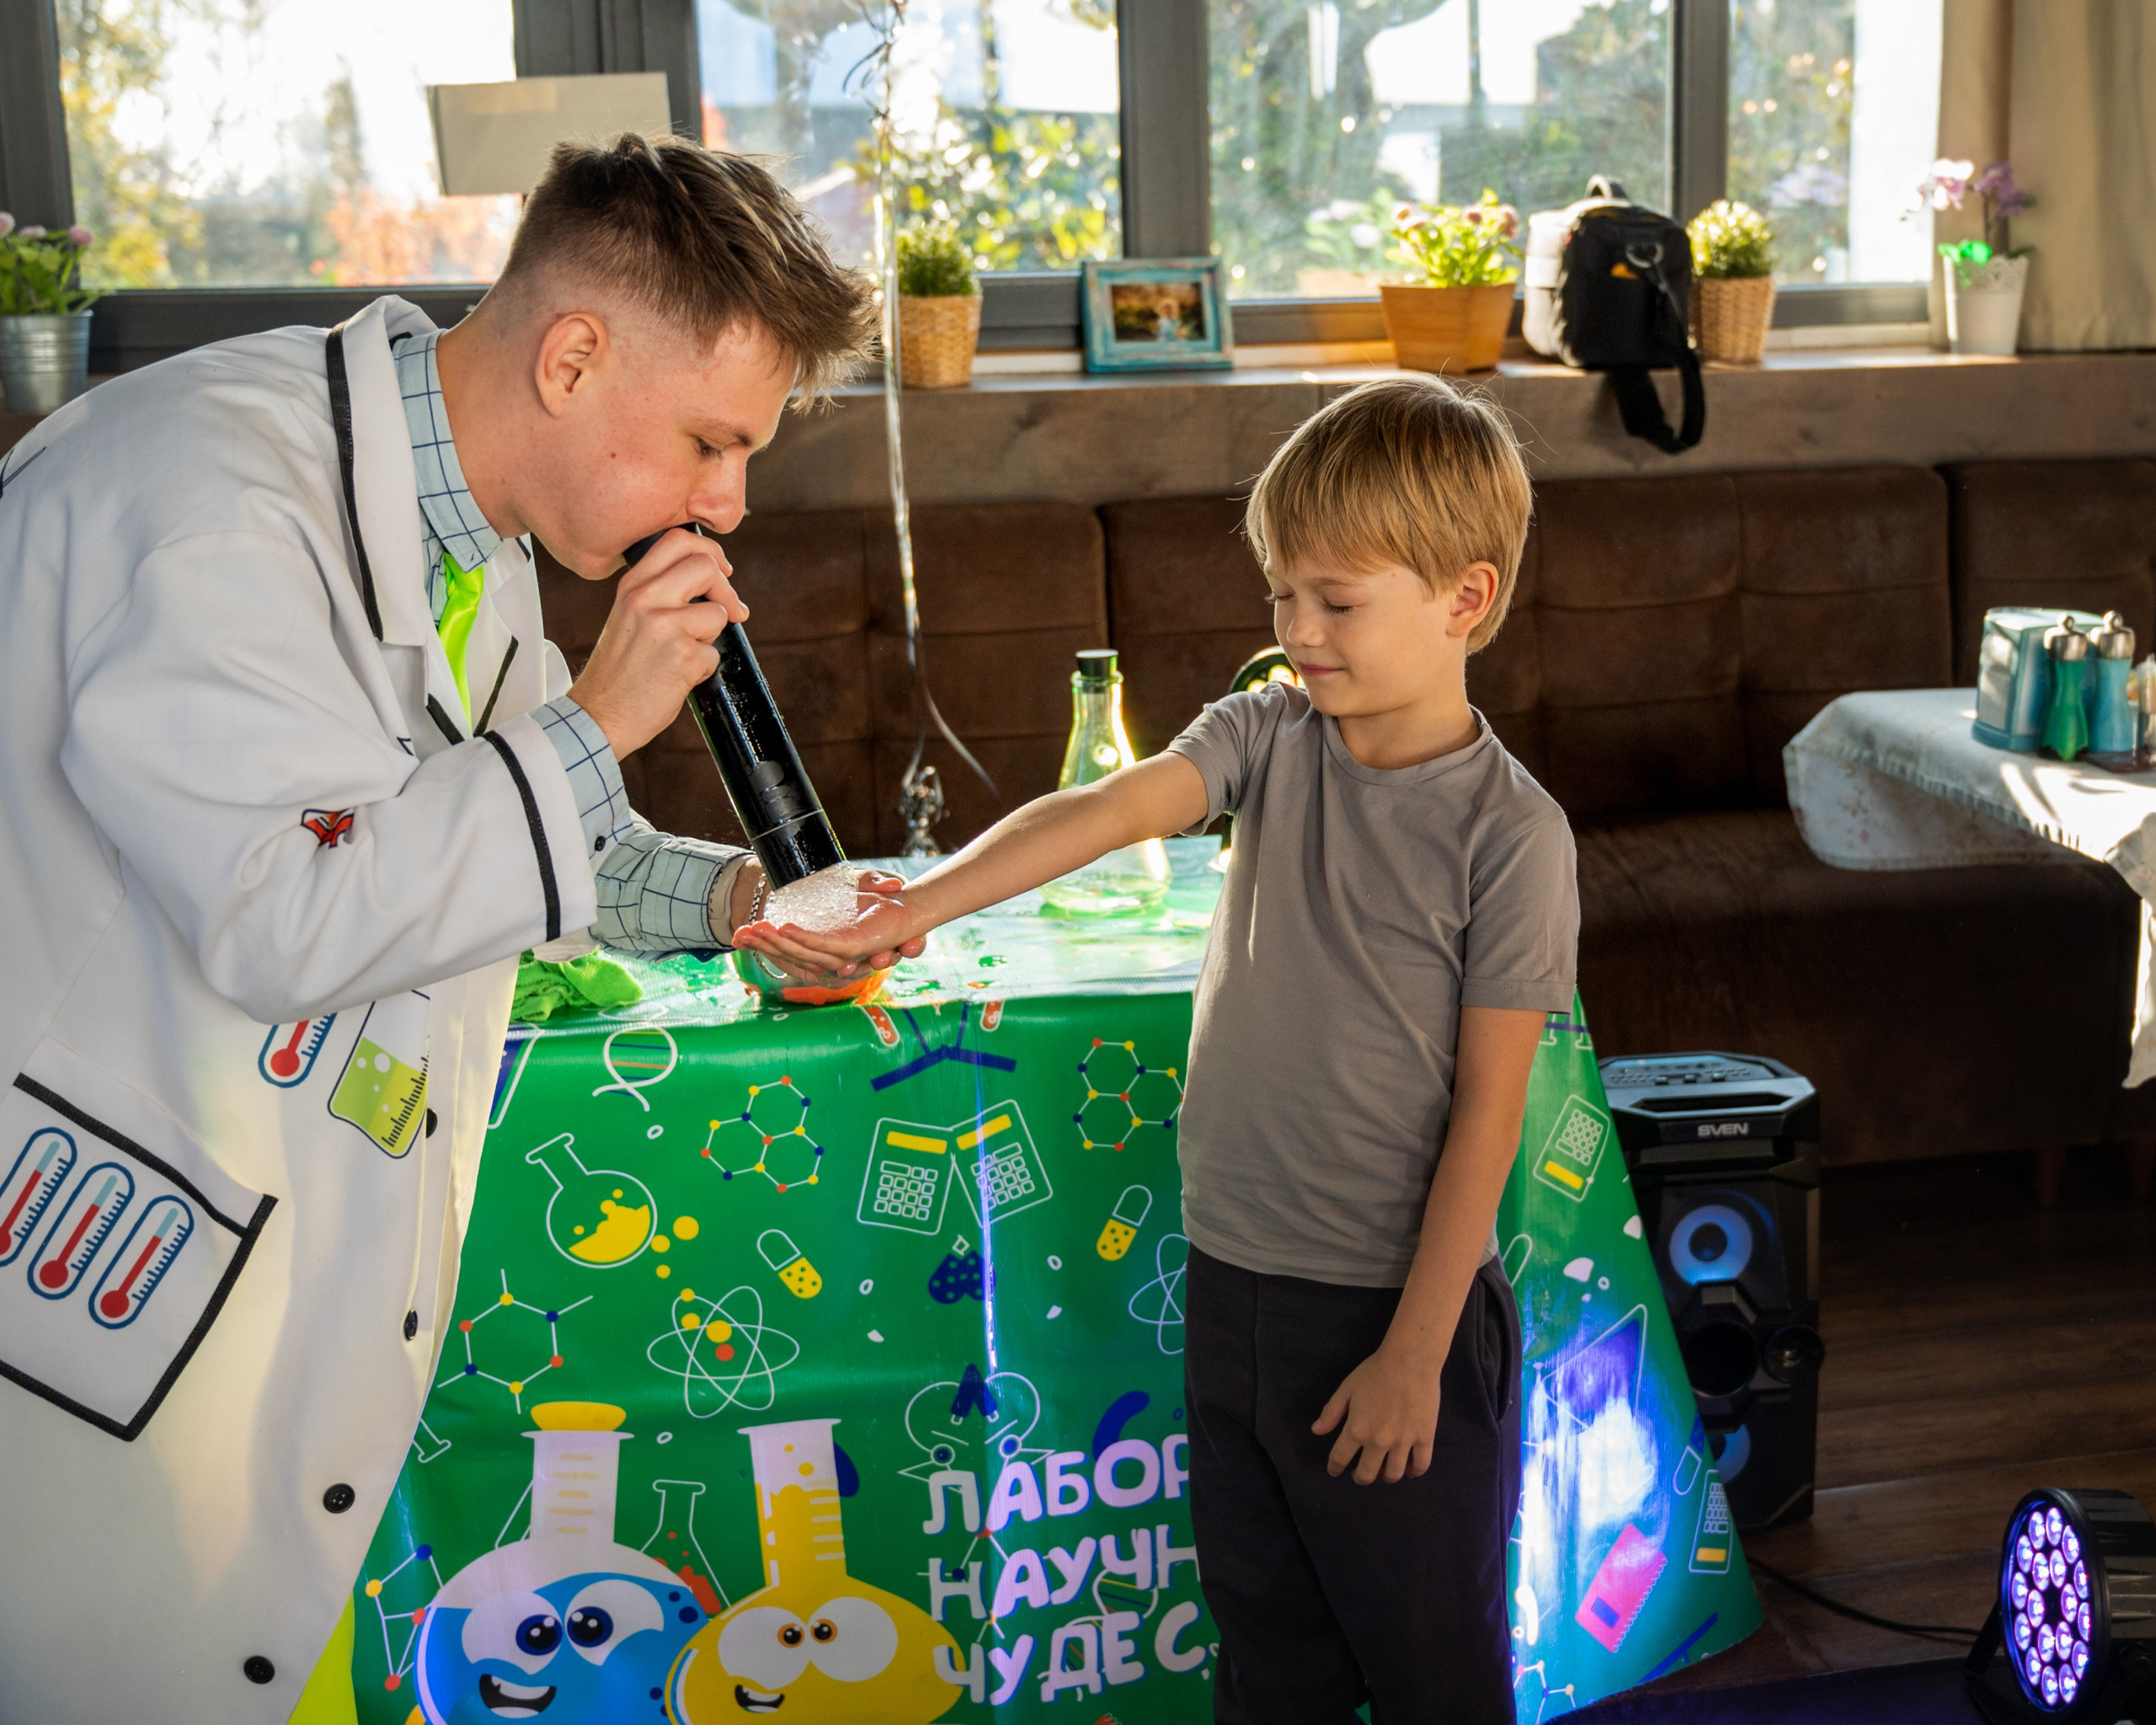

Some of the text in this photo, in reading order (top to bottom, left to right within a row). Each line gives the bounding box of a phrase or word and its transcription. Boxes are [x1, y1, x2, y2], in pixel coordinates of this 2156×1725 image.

[1698, 1122, 1748, 1137] SVEN
[928, 1524, 1201, 1622] НАУЧН
[932, 1601, 1207, 1706] ЧУДЕС
